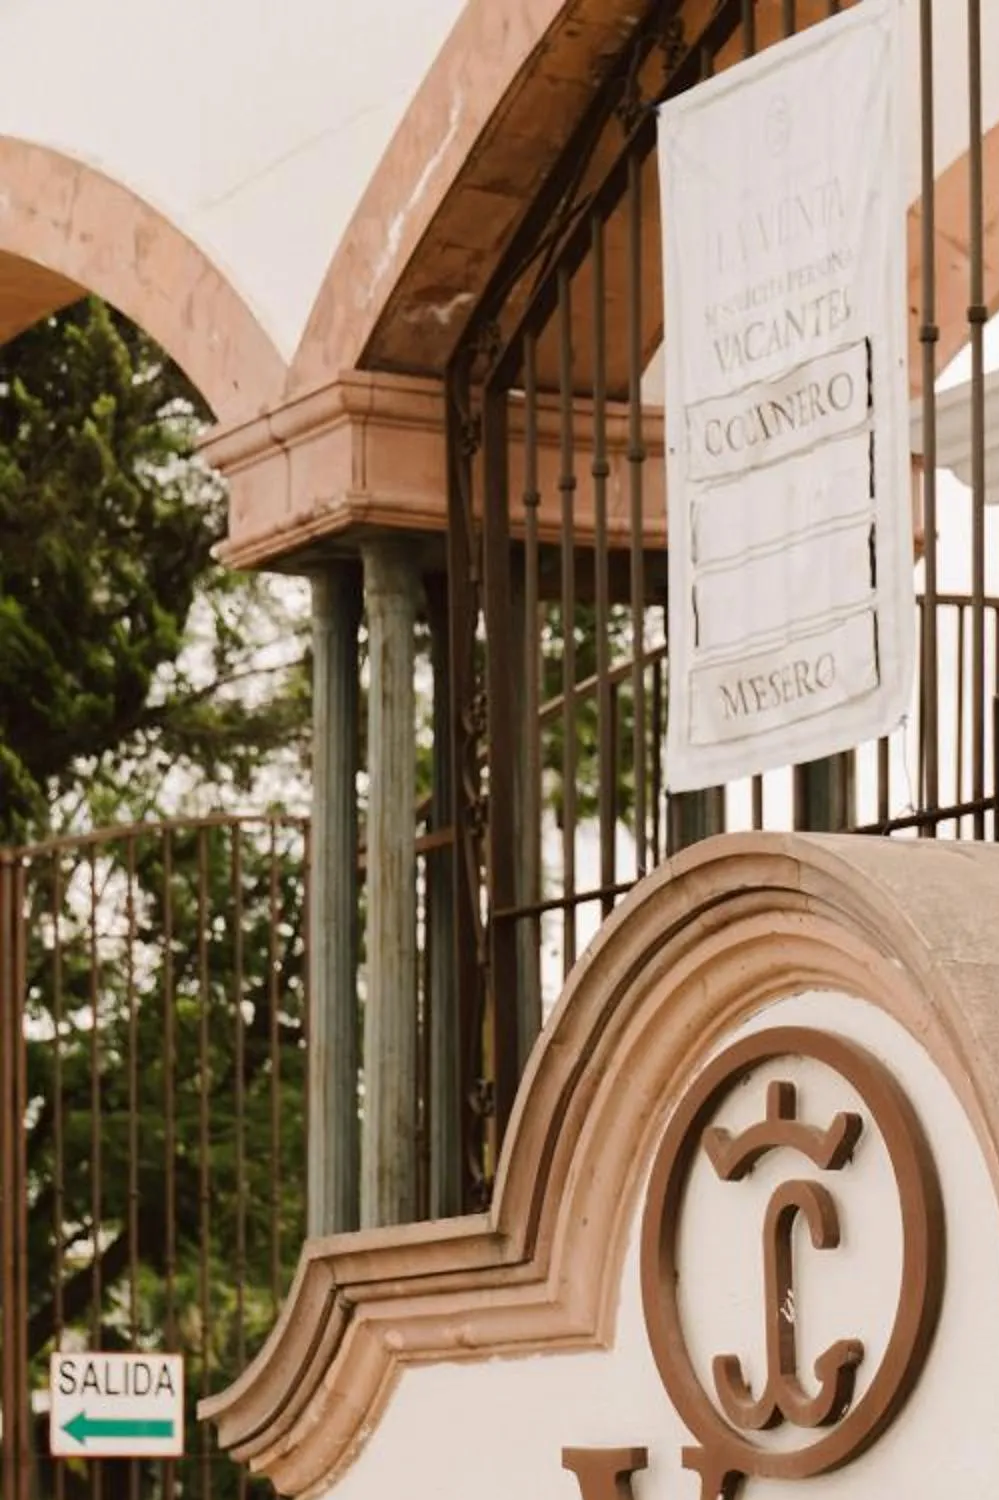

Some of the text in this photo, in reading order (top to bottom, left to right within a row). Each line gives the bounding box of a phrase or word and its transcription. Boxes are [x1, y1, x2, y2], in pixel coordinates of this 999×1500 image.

[713, 285, 851, 374] VACANTES
[718, 653, 837, 721] MESERO
[59, 1361, 175, 1396] SALIDA
